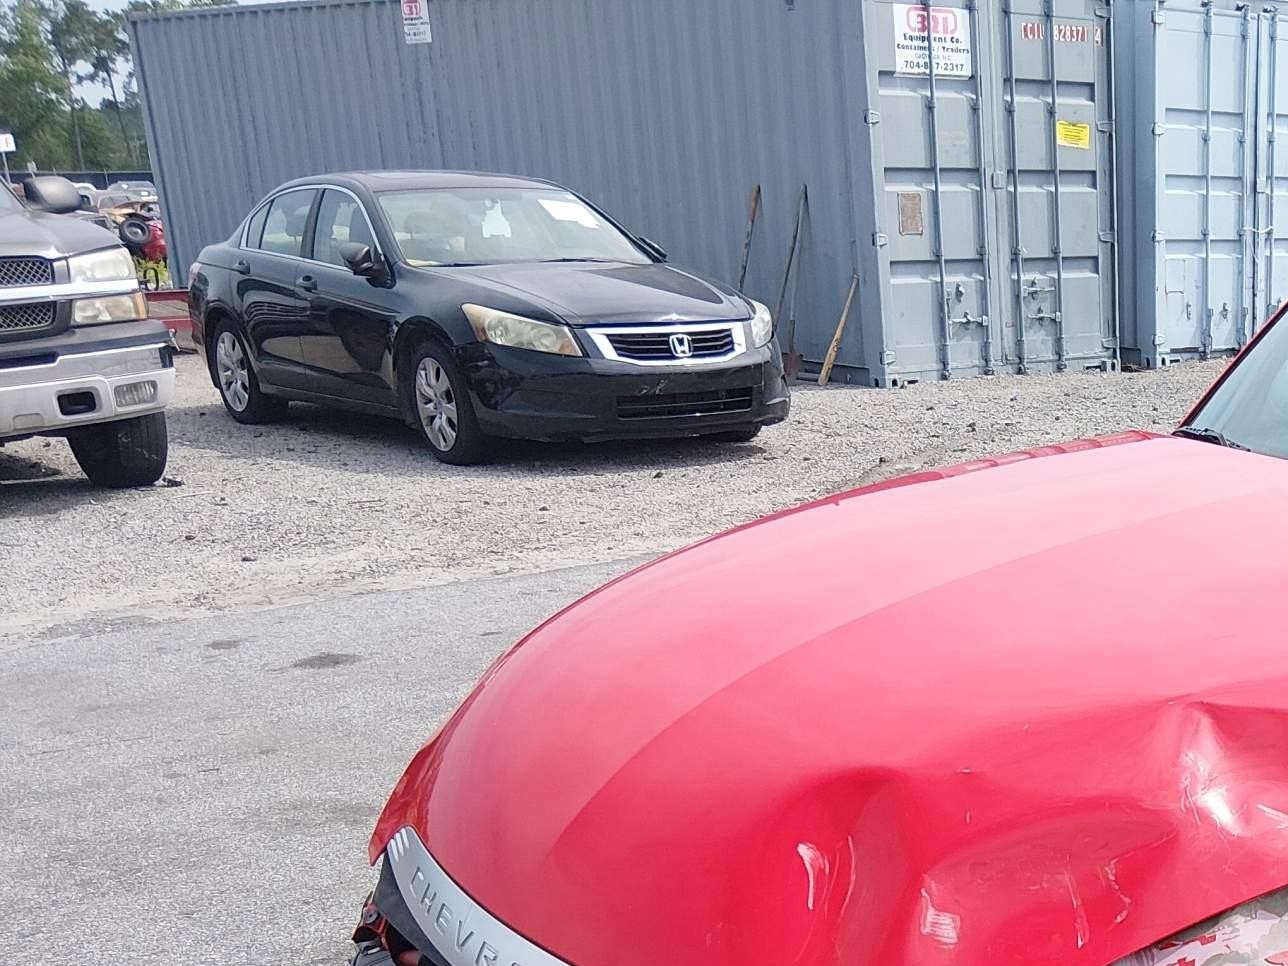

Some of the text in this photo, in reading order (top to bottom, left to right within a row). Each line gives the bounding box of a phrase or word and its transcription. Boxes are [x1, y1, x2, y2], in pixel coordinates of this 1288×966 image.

[903, 32, 963, 44] Equipent Co.
[1054, 24, 1088, 42] 828371
[942, 46, 970, 54] Trailers
